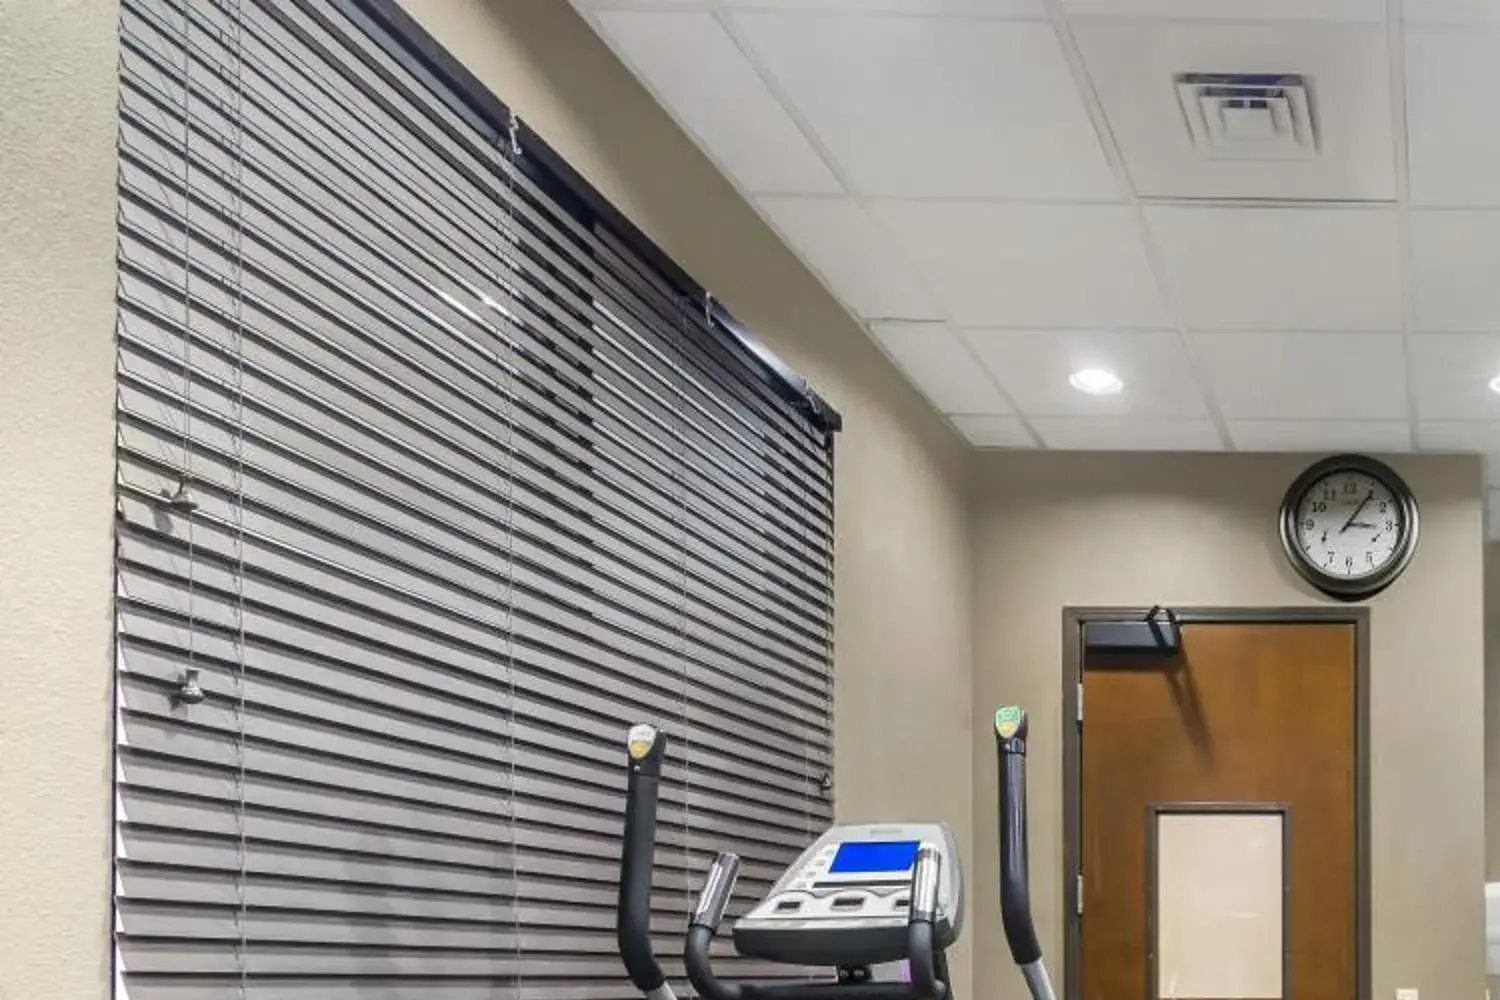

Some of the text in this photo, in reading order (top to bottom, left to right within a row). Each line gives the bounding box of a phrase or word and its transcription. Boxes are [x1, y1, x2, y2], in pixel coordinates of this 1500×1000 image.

[1312, 502, 1327, 512] 10
[1385, 520, 1393, 532] 3
[1345, 556, 1353, 567] 6
